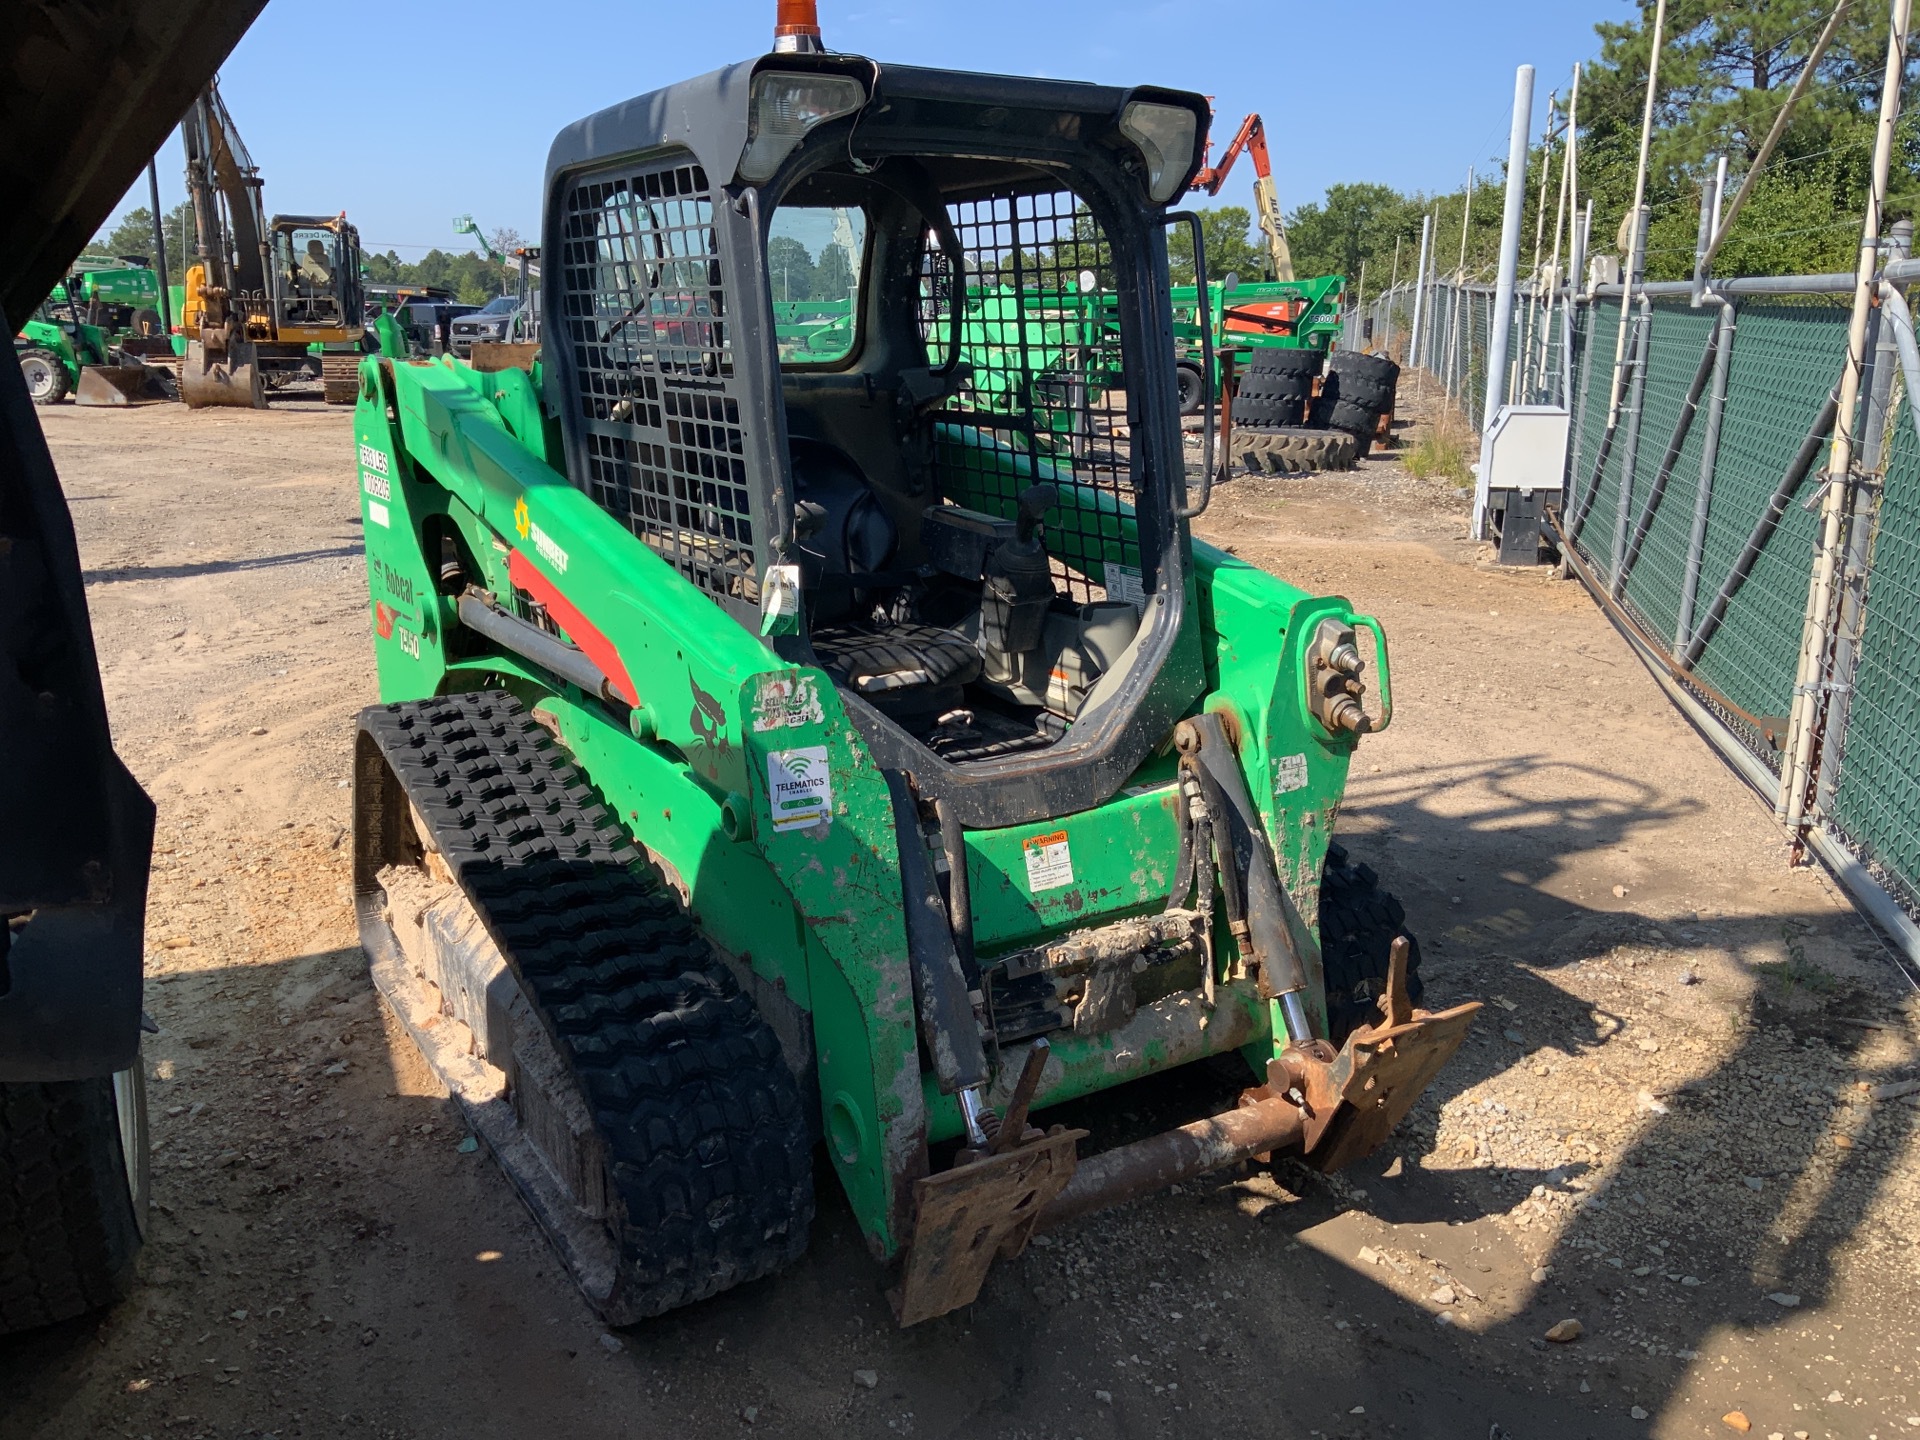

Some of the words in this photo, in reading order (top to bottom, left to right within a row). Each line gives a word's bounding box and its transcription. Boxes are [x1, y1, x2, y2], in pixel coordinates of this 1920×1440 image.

[1269, 197, 1279, 215] JLG
[375, 450, 388, 474] LBS
[531, 521, 569, 572] SUNBELT
[385, 563, 414, 606] Bobcat
[399, 625, 420, 661] T550
[776, 778, 824, 792] TELEMATICS
[1033, 833, 1065, 845] WARNING
